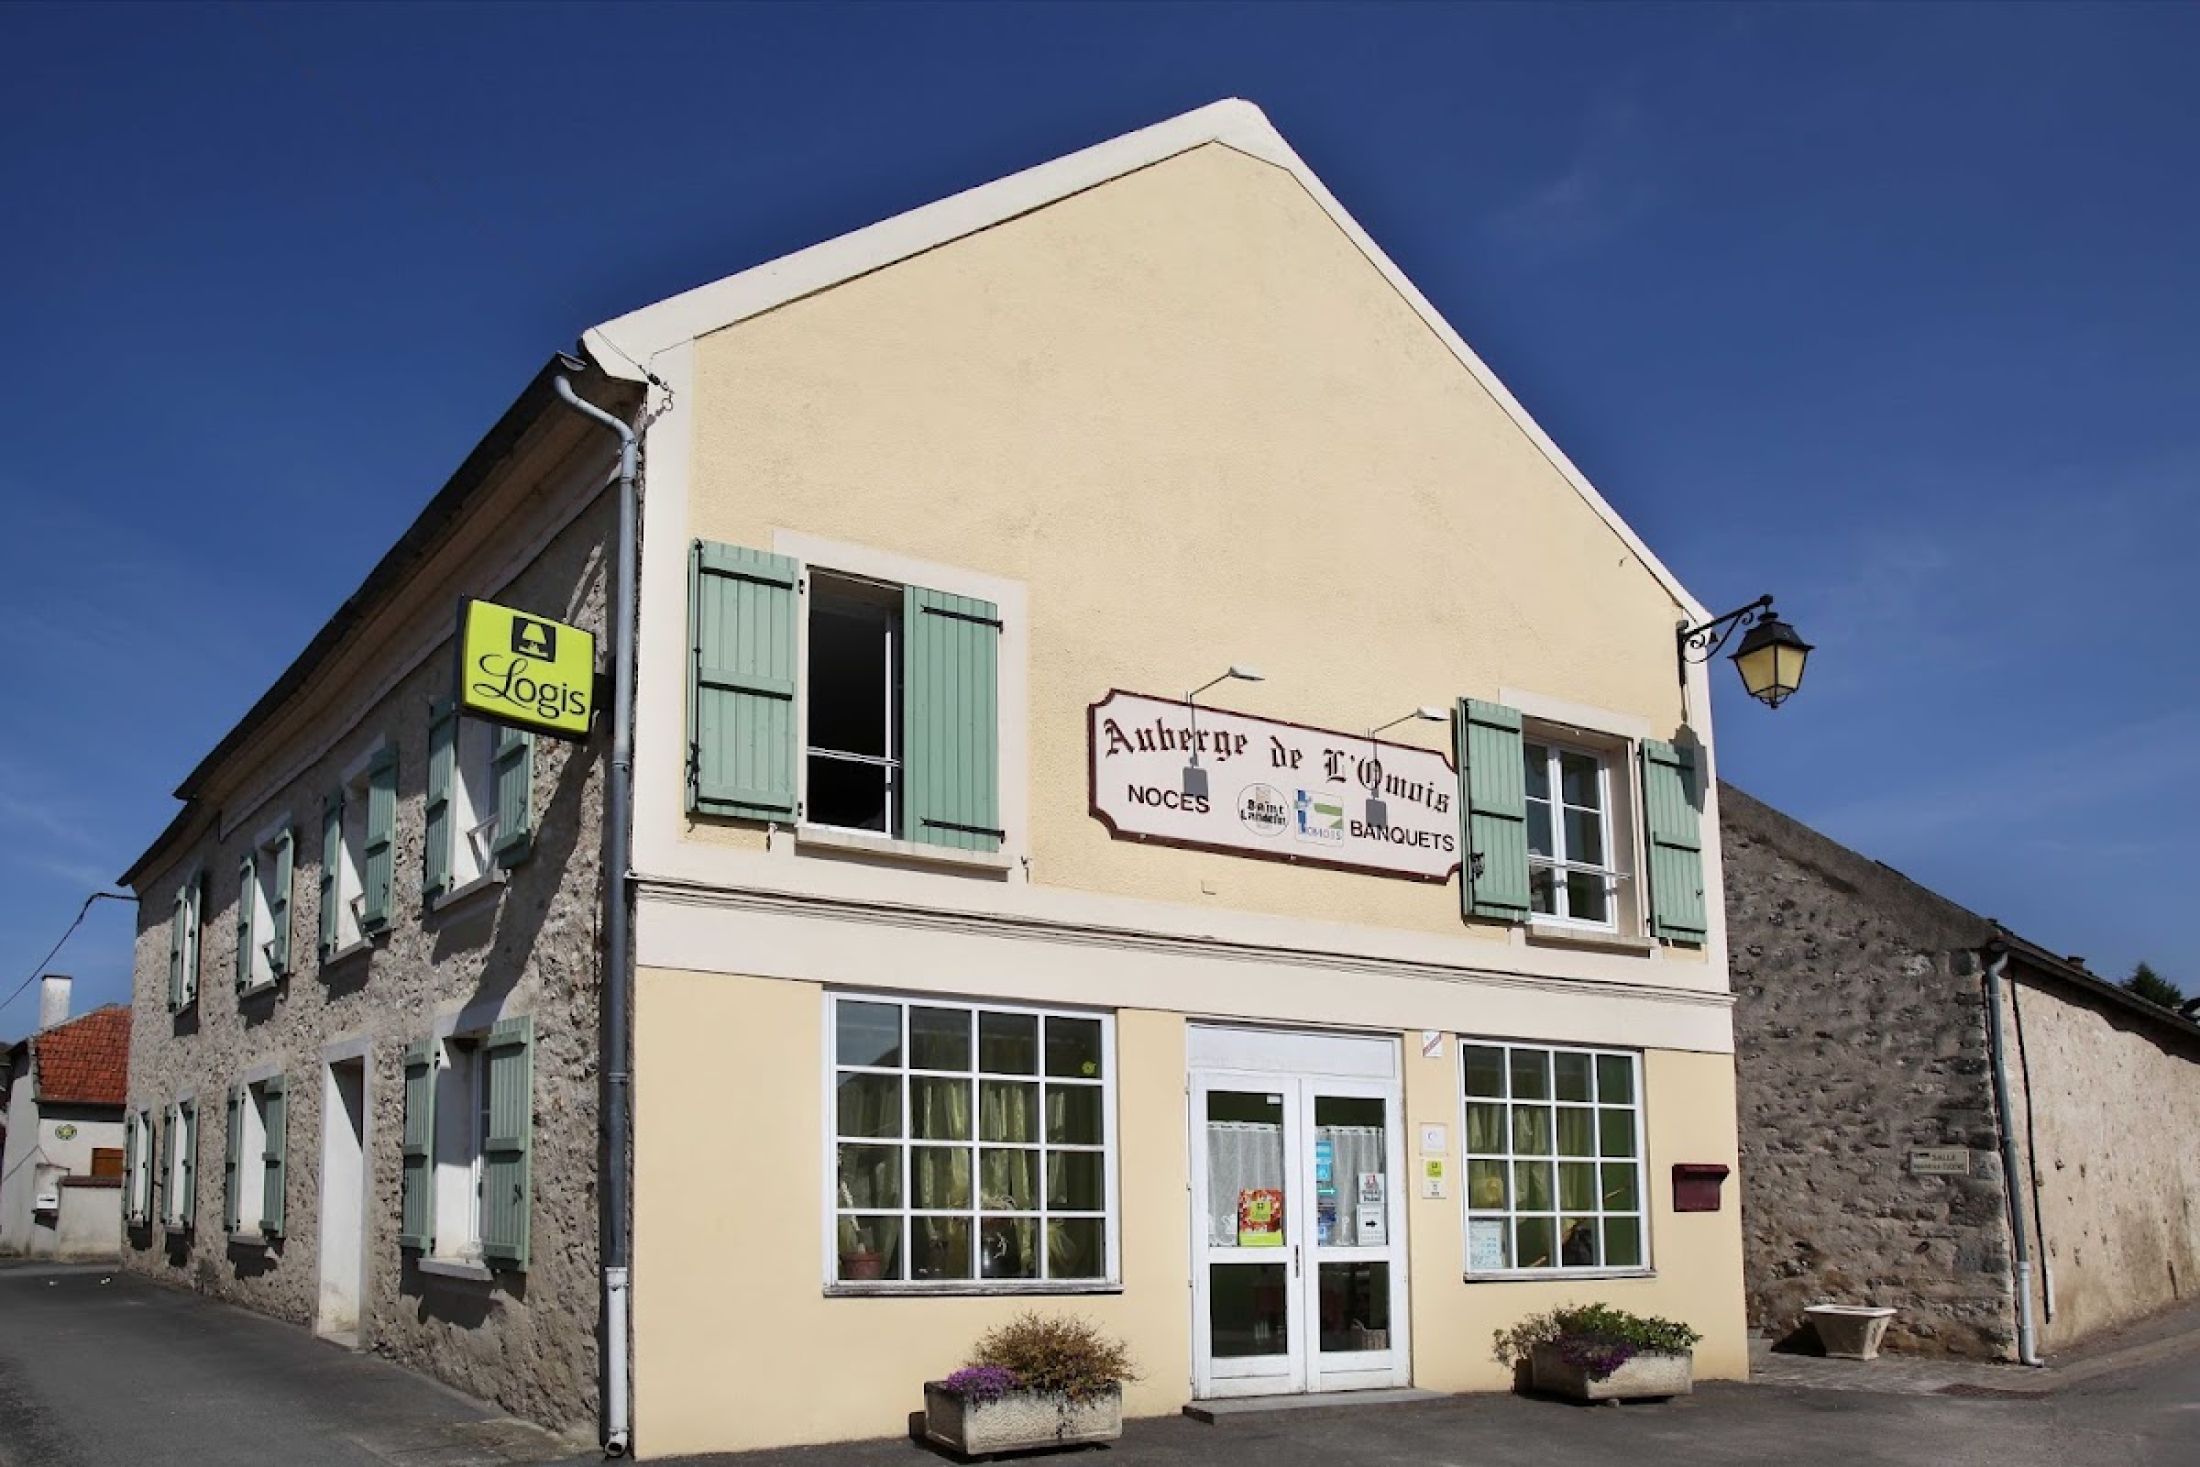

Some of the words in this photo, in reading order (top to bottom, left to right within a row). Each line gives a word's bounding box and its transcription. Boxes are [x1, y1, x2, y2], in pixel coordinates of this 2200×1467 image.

[472, 653, 586, 720] Logis
[1103, 716, 1248, 762] Auberge
[1269, 734, 1303, 770] de
[1323, 747, 1451, 814] L'Omois
[1128, 784, 1211, 814] NOCES
[1350, 819, 1455, 852] BANQUETS
